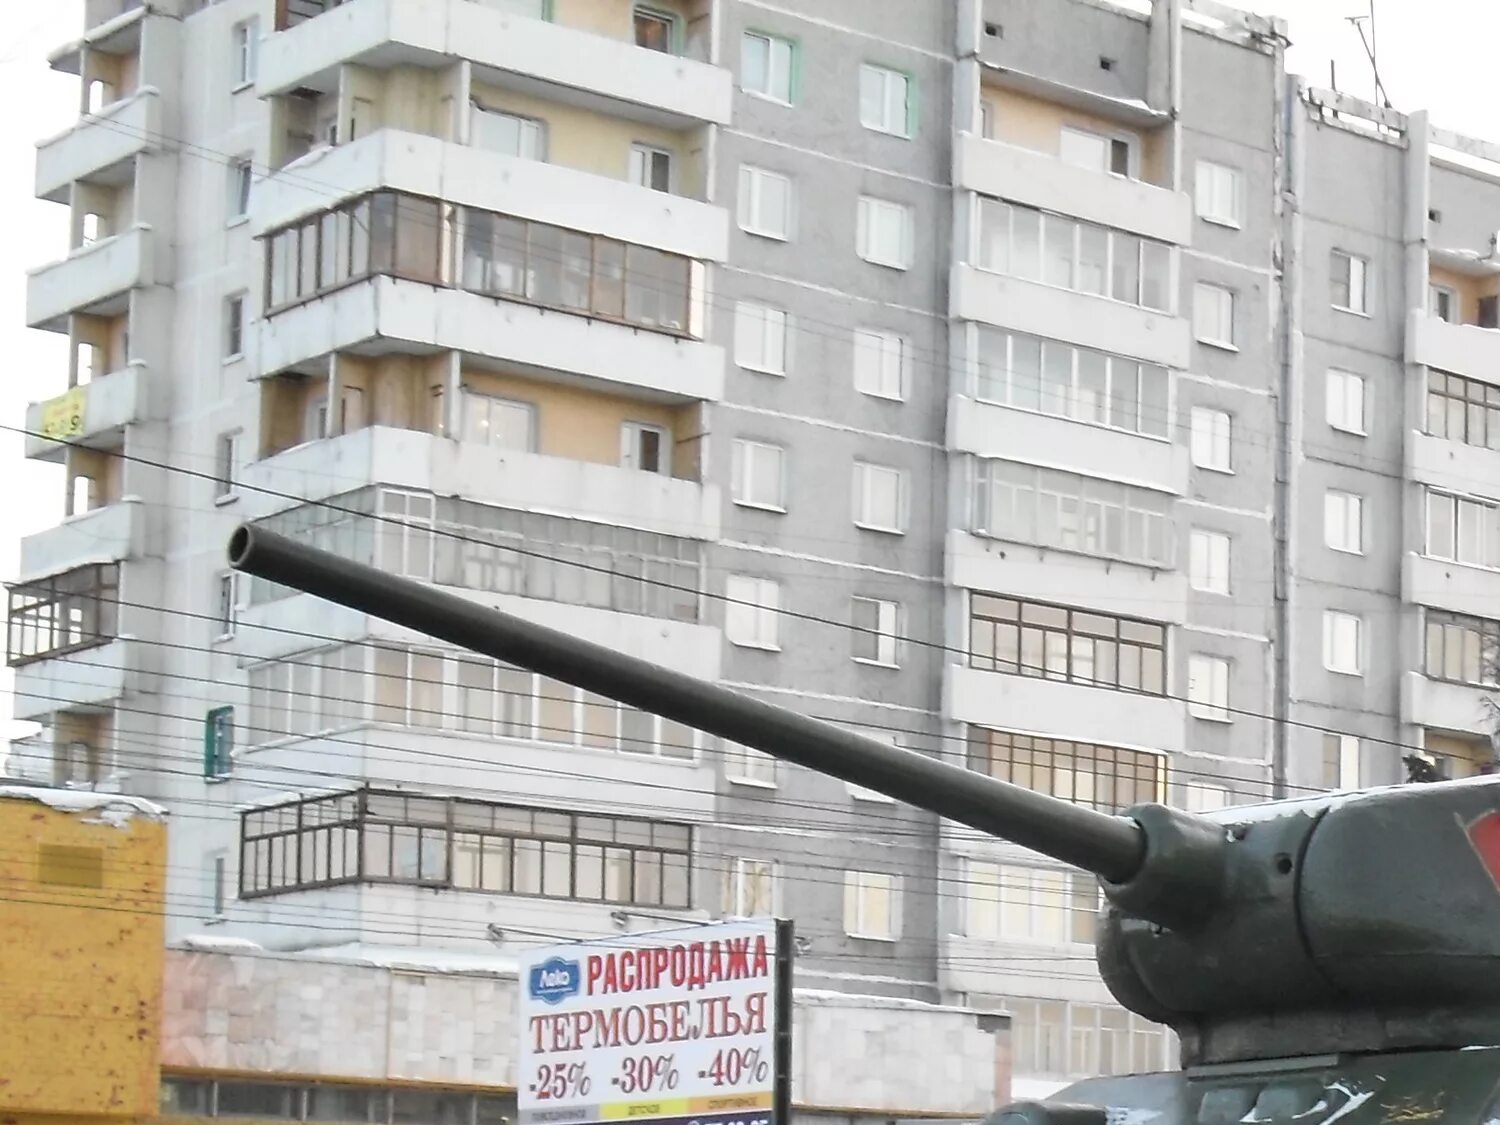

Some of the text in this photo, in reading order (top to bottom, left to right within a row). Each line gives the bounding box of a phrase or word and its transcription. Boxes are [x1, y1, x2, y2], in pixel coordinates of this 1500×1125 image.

[586, 934, 769, 996] РАСПРОДАЖА
[529, 991, 768, 1054] ТЕРМОБЕЛЬЯ
[529, 1045, 768, 1100] -25% -30% -40%
